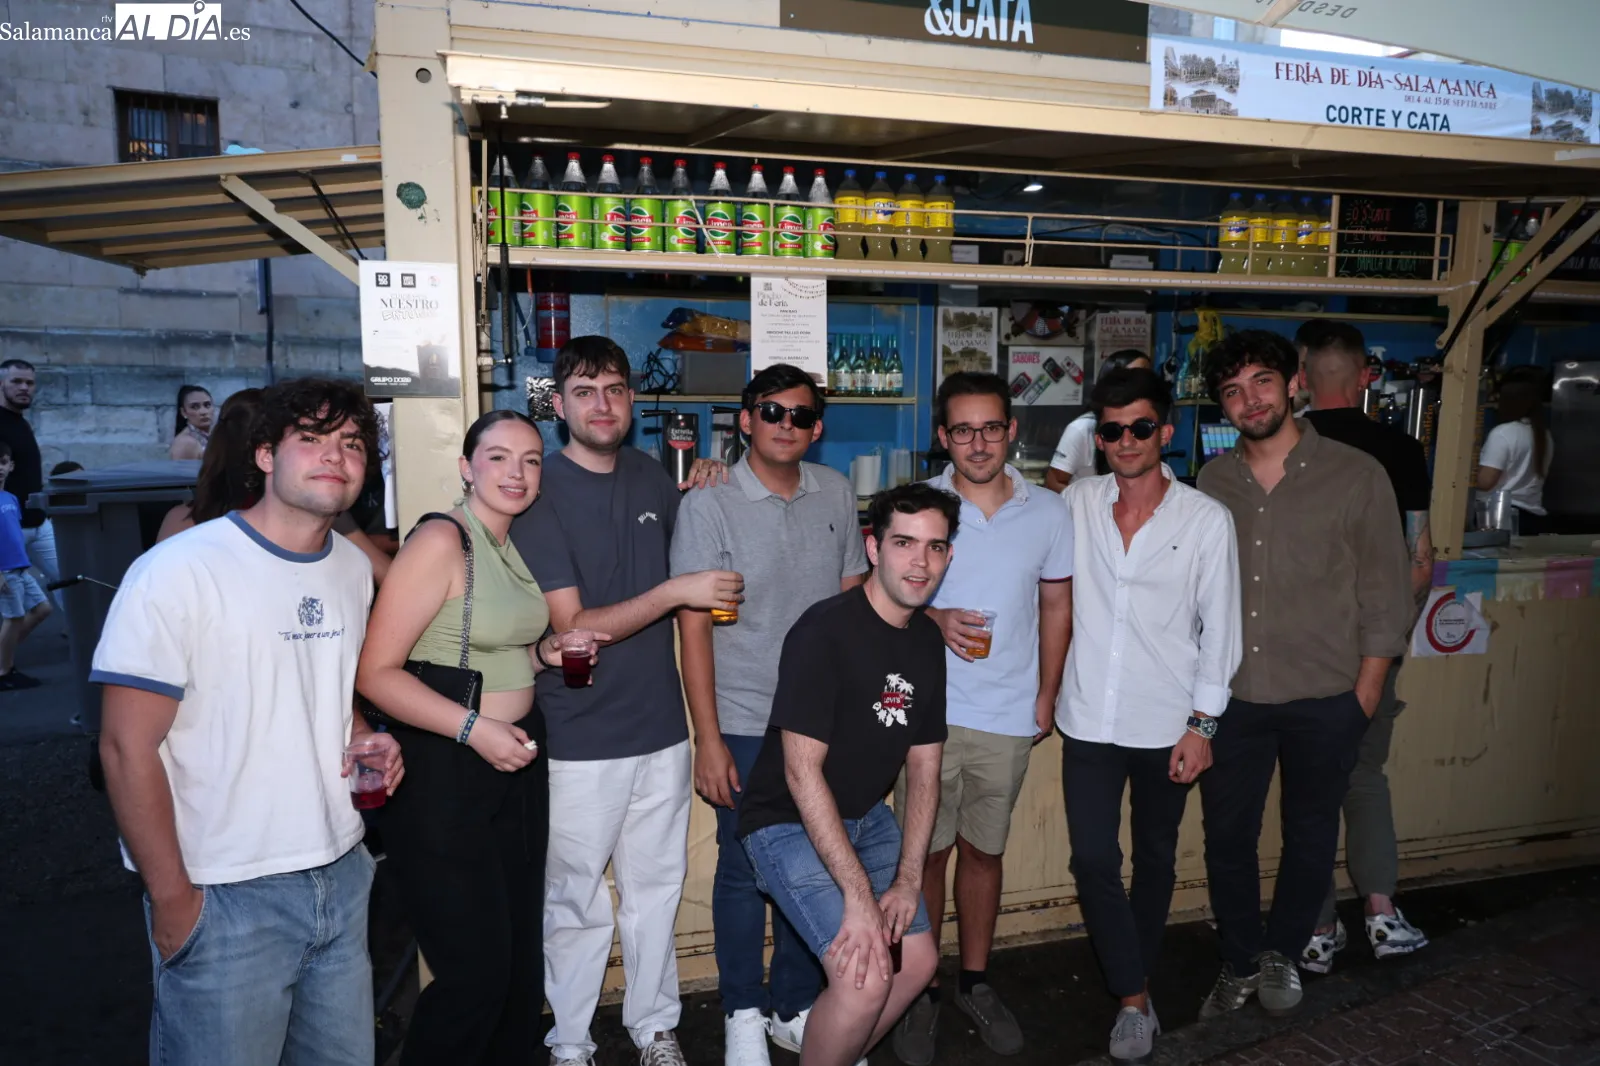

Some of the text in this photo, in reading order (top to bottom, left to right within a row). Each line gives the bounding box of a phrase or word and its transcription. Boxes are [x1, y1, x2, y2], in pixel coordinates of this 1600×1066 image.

[1330, 67, 1351, 86] DE
[1416, 95, 1422, 103] 4
[1424, 96, 1432, 104] AL
[1443, 98, 1451, 106] DE
[1326, 104, 1451, 132] CORTE Y CATA
[380, 298, 439, 310] NUESTRO
